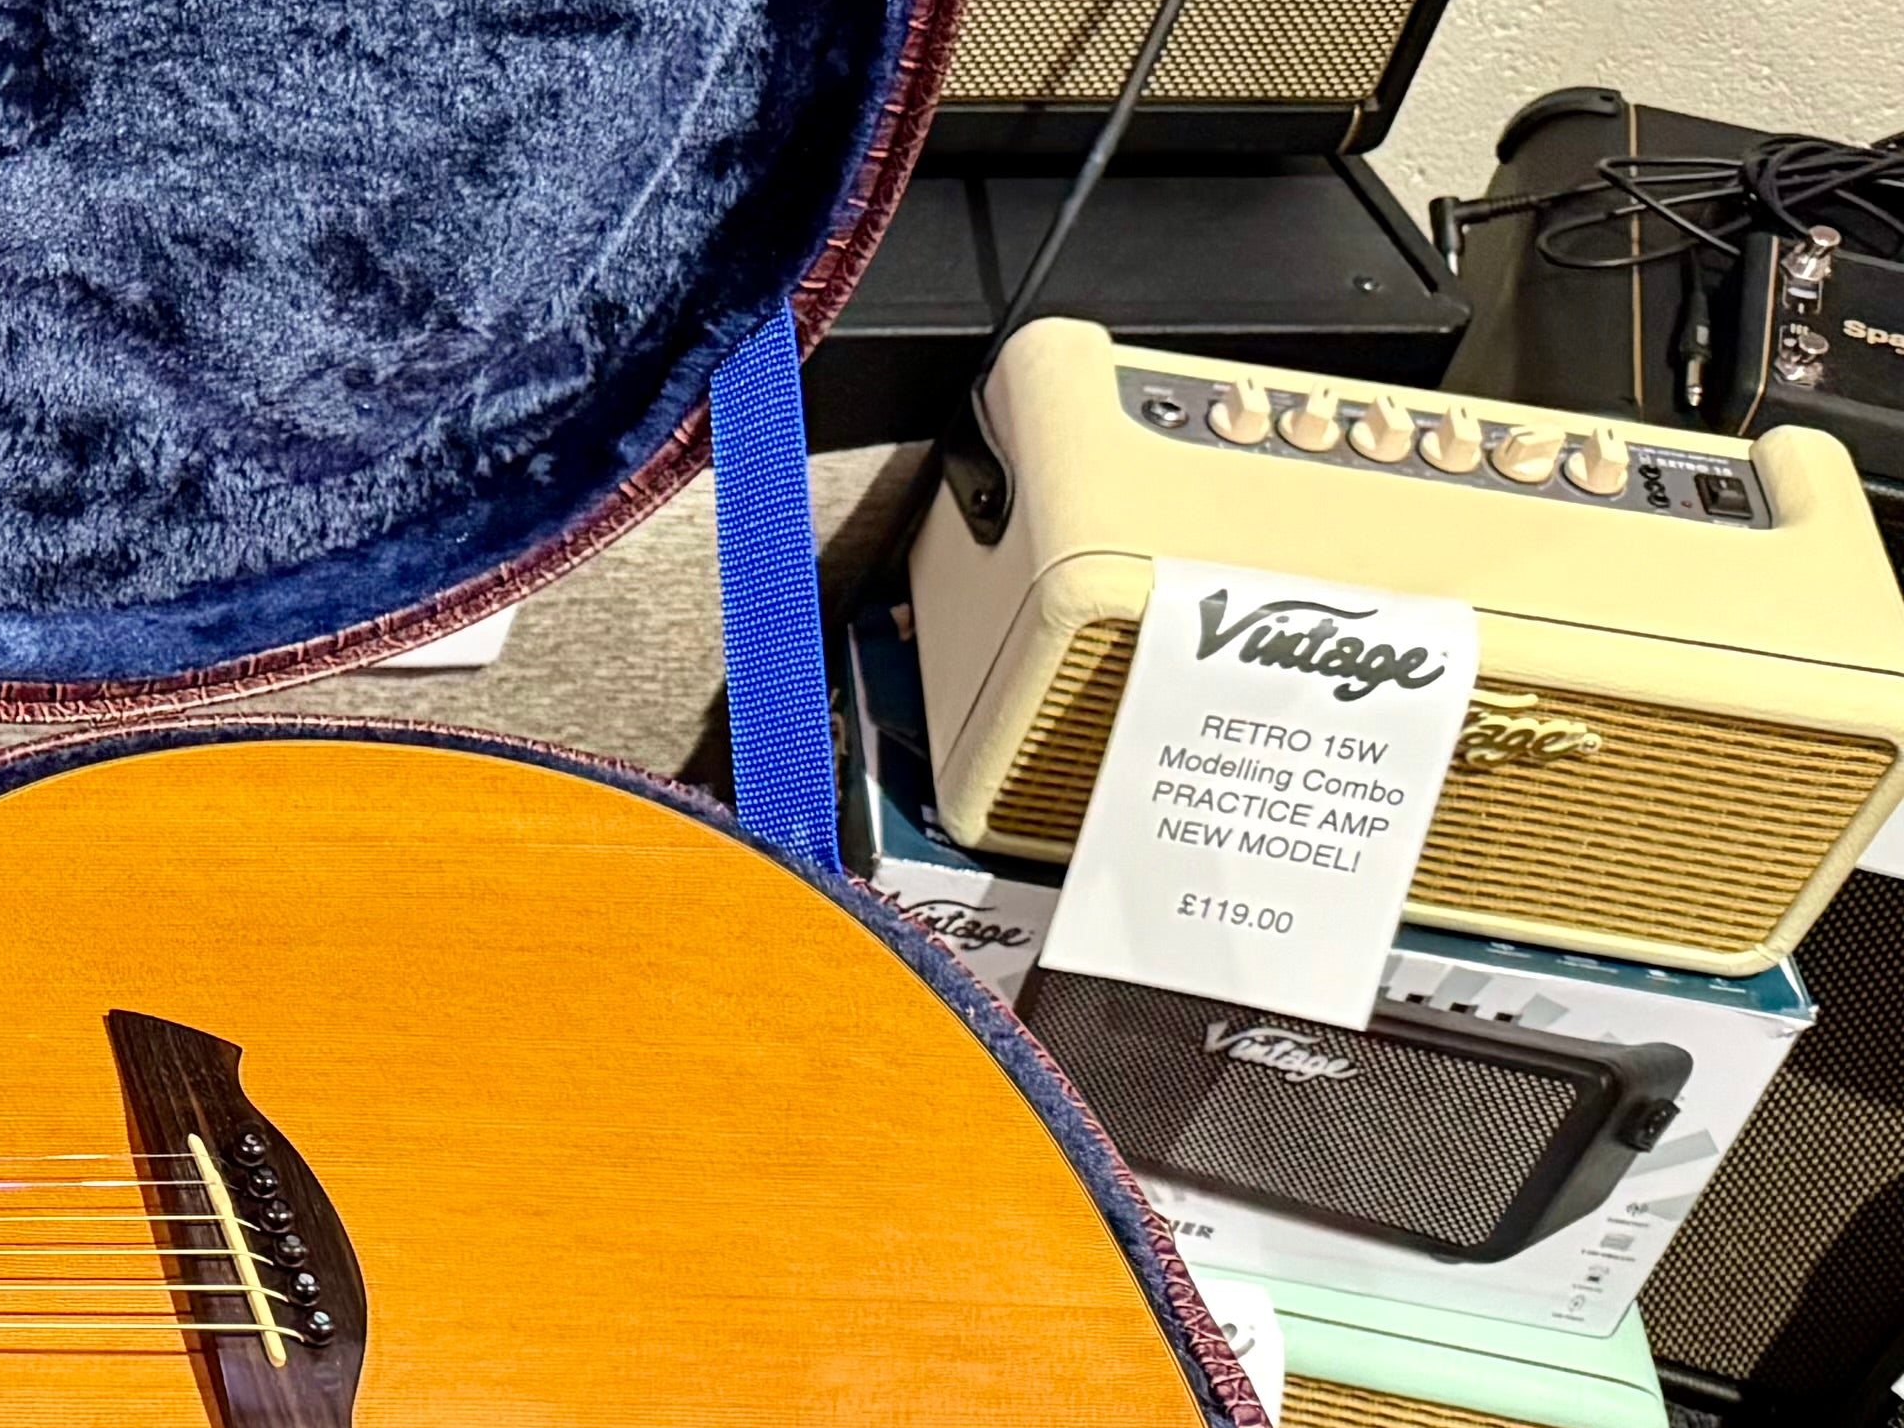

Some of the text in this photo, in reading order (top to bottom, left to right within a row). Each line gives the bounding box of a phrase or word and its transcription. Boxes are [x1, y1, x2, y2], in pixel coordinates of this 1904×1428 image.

[1195, 588, 1446, 702] Vintage
[1200, 715, 1390, 765] RETRO 15W
[1158, 745, 1405, 806] Modelling Combo
[1151, 780, 1390, 839] PRACTICE AMP
[1156, 817, 1362, 873] NEW MODEL!
[1176, 893, 1294, 934] £119.00
[1202, 1020, 1358, 1082] Vintage
